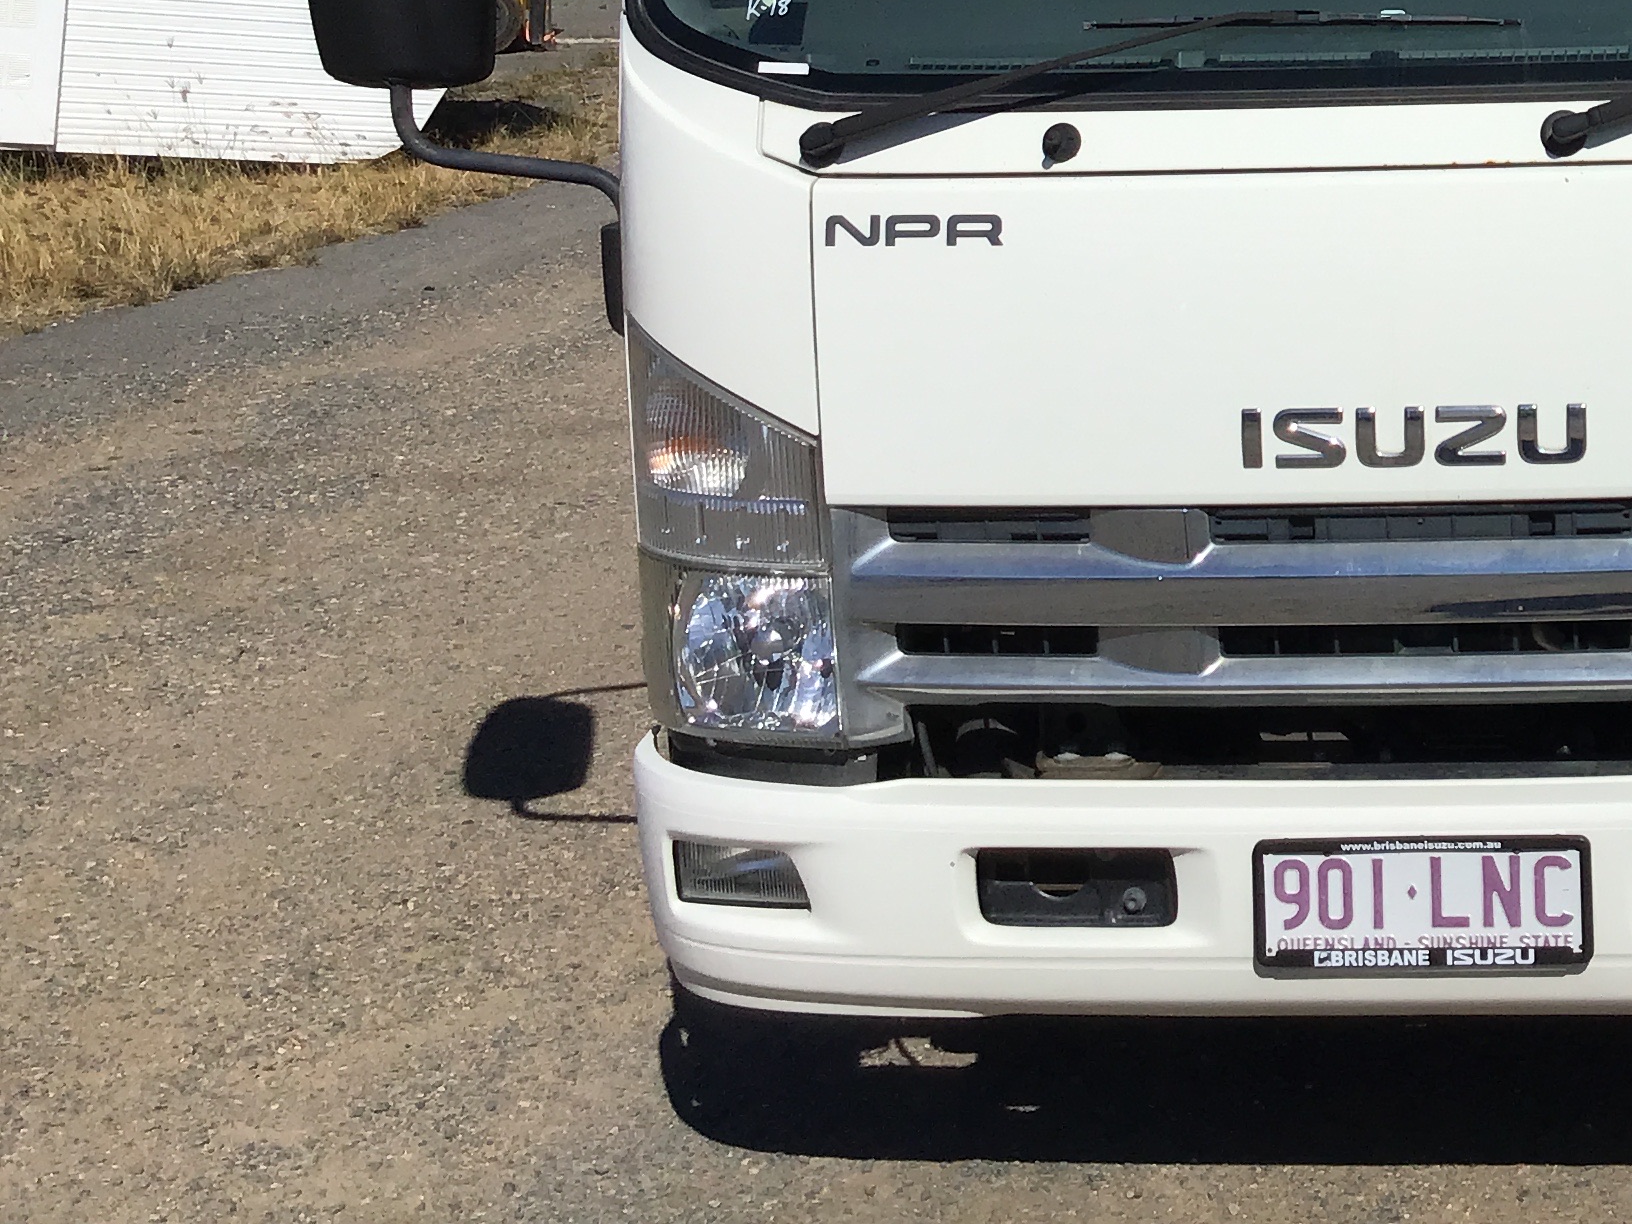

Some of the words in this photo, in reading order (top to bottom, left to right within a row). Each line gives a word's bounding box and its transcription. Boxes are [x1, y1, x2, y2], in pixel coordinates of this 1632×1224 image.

[825, 214, 1004, 247] NPR
[1241, 402, 1587, 469] ISUZU
[1340, 839, 1502, 852] www.brisbaneisuzu.com.au
[1276, 936, 1397, 951] QUEENSLAND
[1417, 934, 1509, 948] SUNSHINE
[1519, 933, 1574, 948] STATE
[1330, 950, 1430, 967] BRISBANE
[1446, 948, 1536, 966] ISUZU
